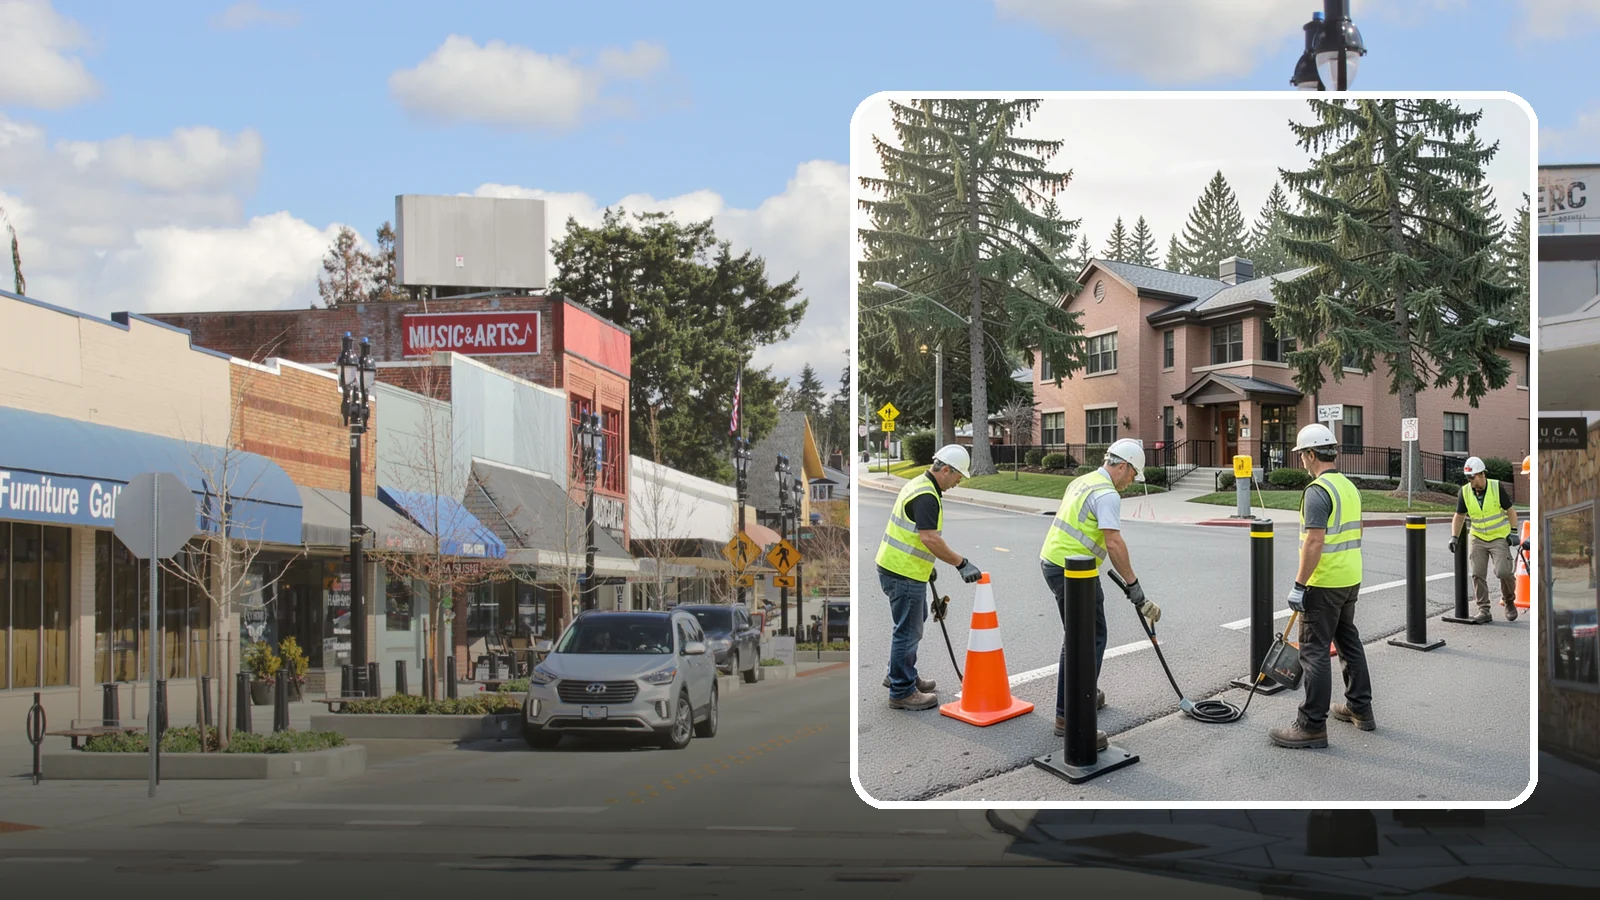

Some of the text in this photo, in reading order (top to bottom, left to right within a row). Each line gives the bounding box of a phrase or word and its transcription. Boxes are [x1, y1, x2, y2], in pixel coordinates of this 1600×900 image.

[409, 323, 520, 349] MUSIC&ARTS
[0, 471, 122, 519] Furniture Gal
[453, 563, 479, 574] SUSHI
